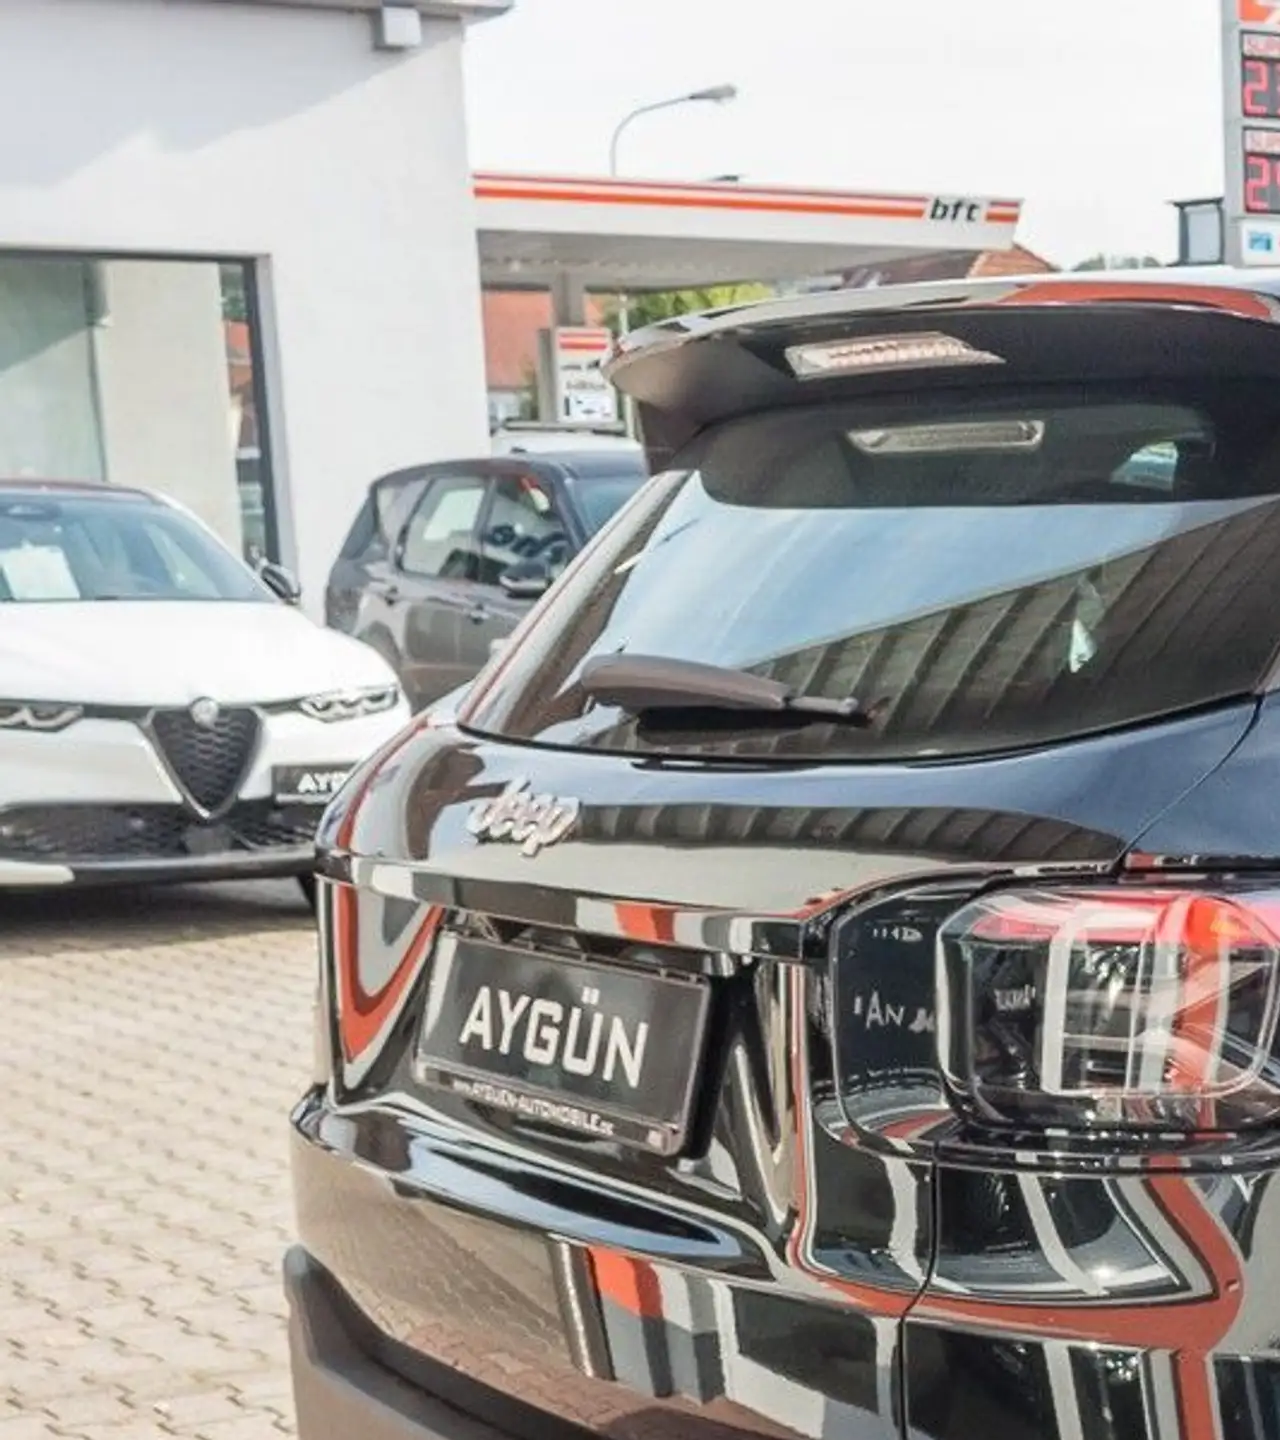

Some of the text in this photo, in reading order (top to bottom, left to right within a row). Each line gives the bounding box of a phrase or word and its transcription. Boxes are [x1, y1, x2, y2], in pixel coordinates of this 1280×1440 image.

[929, 198, 980, 222] bft
[466, 776, 580, 857] Jeep
[458, 986, 648, 1088] AYGÜN
